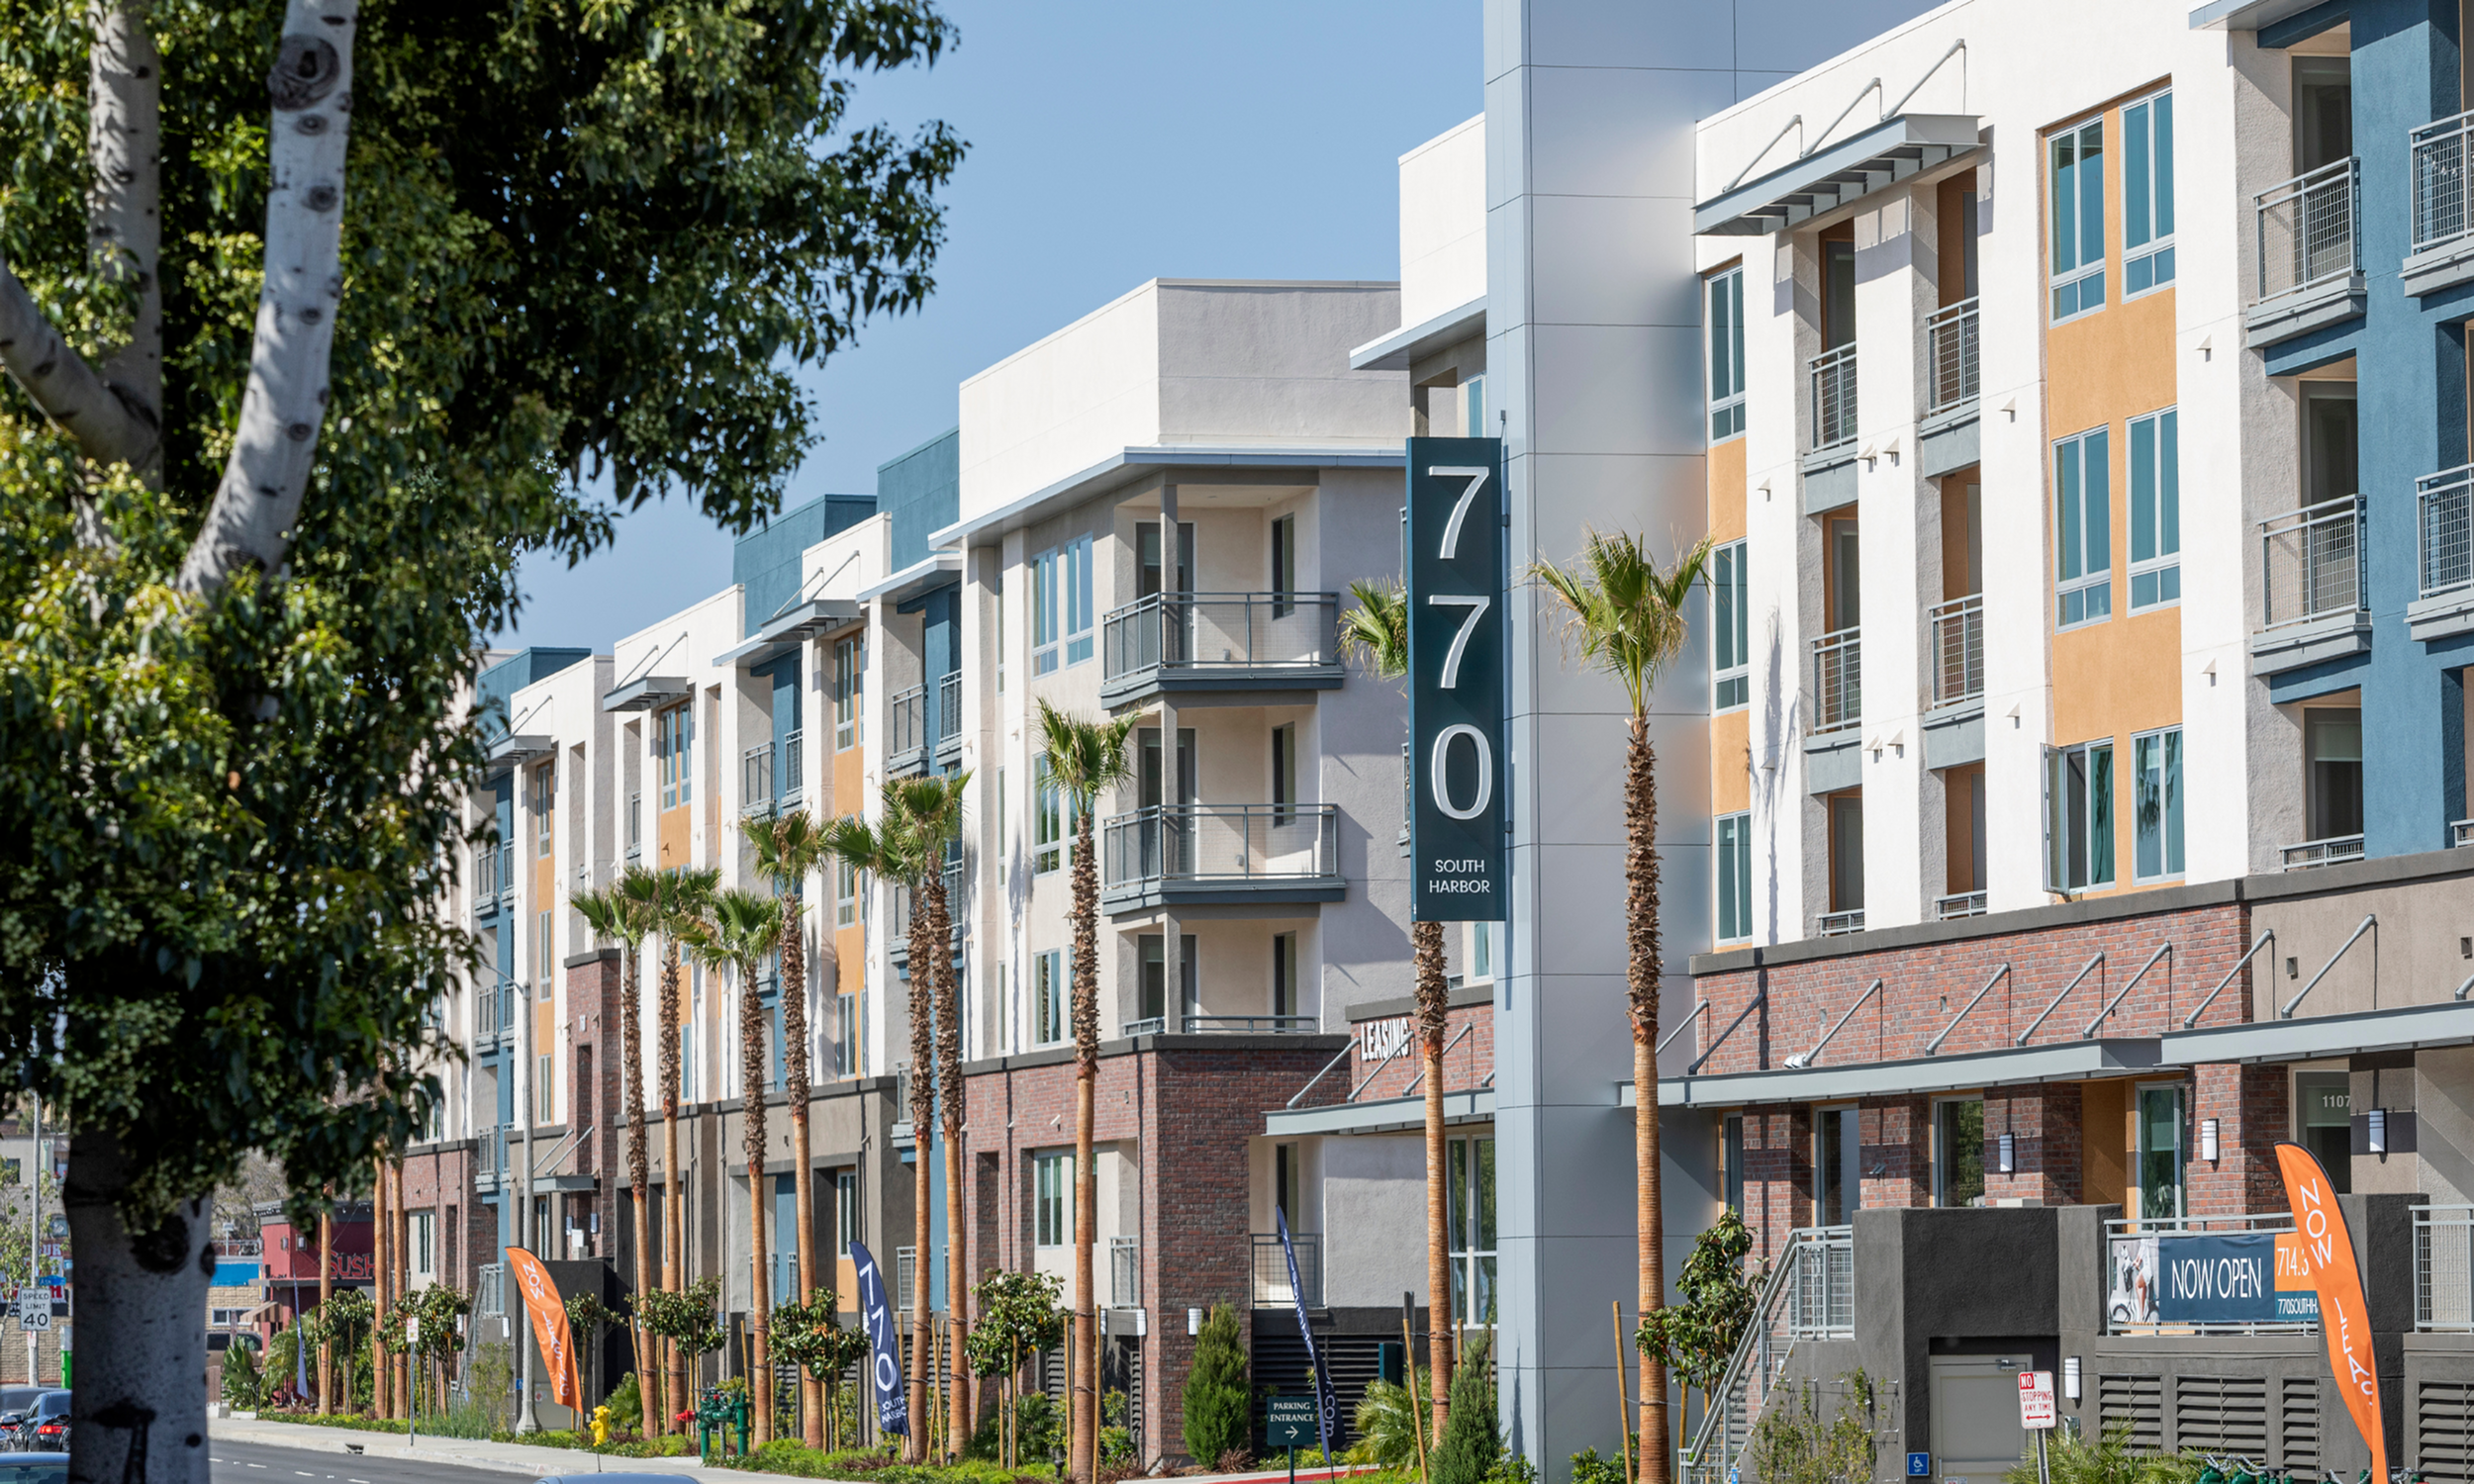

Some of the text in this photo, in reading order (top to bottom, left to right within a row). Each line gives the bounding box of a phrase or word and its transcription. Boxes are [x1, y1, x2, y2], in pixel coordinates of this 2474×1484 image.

[1428, 465, 1493, 821] 770
[1435, 859, 1485, 873] SOUTH
[1429, 880, 1491, 893] HARBOR
[1361, 1017, 1409, 1061] LEASING
[2322, 1095, 2351, 1108] 1107
[2300, 1178, 2331, 1269] NOW
[330, 1250, 376, 1277] SUSH
[522, 1259, 545, 1301] NOW
[2171, 1257, 2262, 1300] NOW OPEN
[23, 1292, 49, 1301] SPEED
[2277, 1297, 2319, 1315] 770SOUTHH
[24, 1313, 48, 1327] 40
[2021, 1375, 2033, 1388] NO
[2022, 1390, 2053, 1403] STOPPING
[1273, 1402, 1311, 1411] PARKING
[2039, 1403, 2052, 1412] TIME
[1270, 1414, 1315, 1423] ENTRANCE
